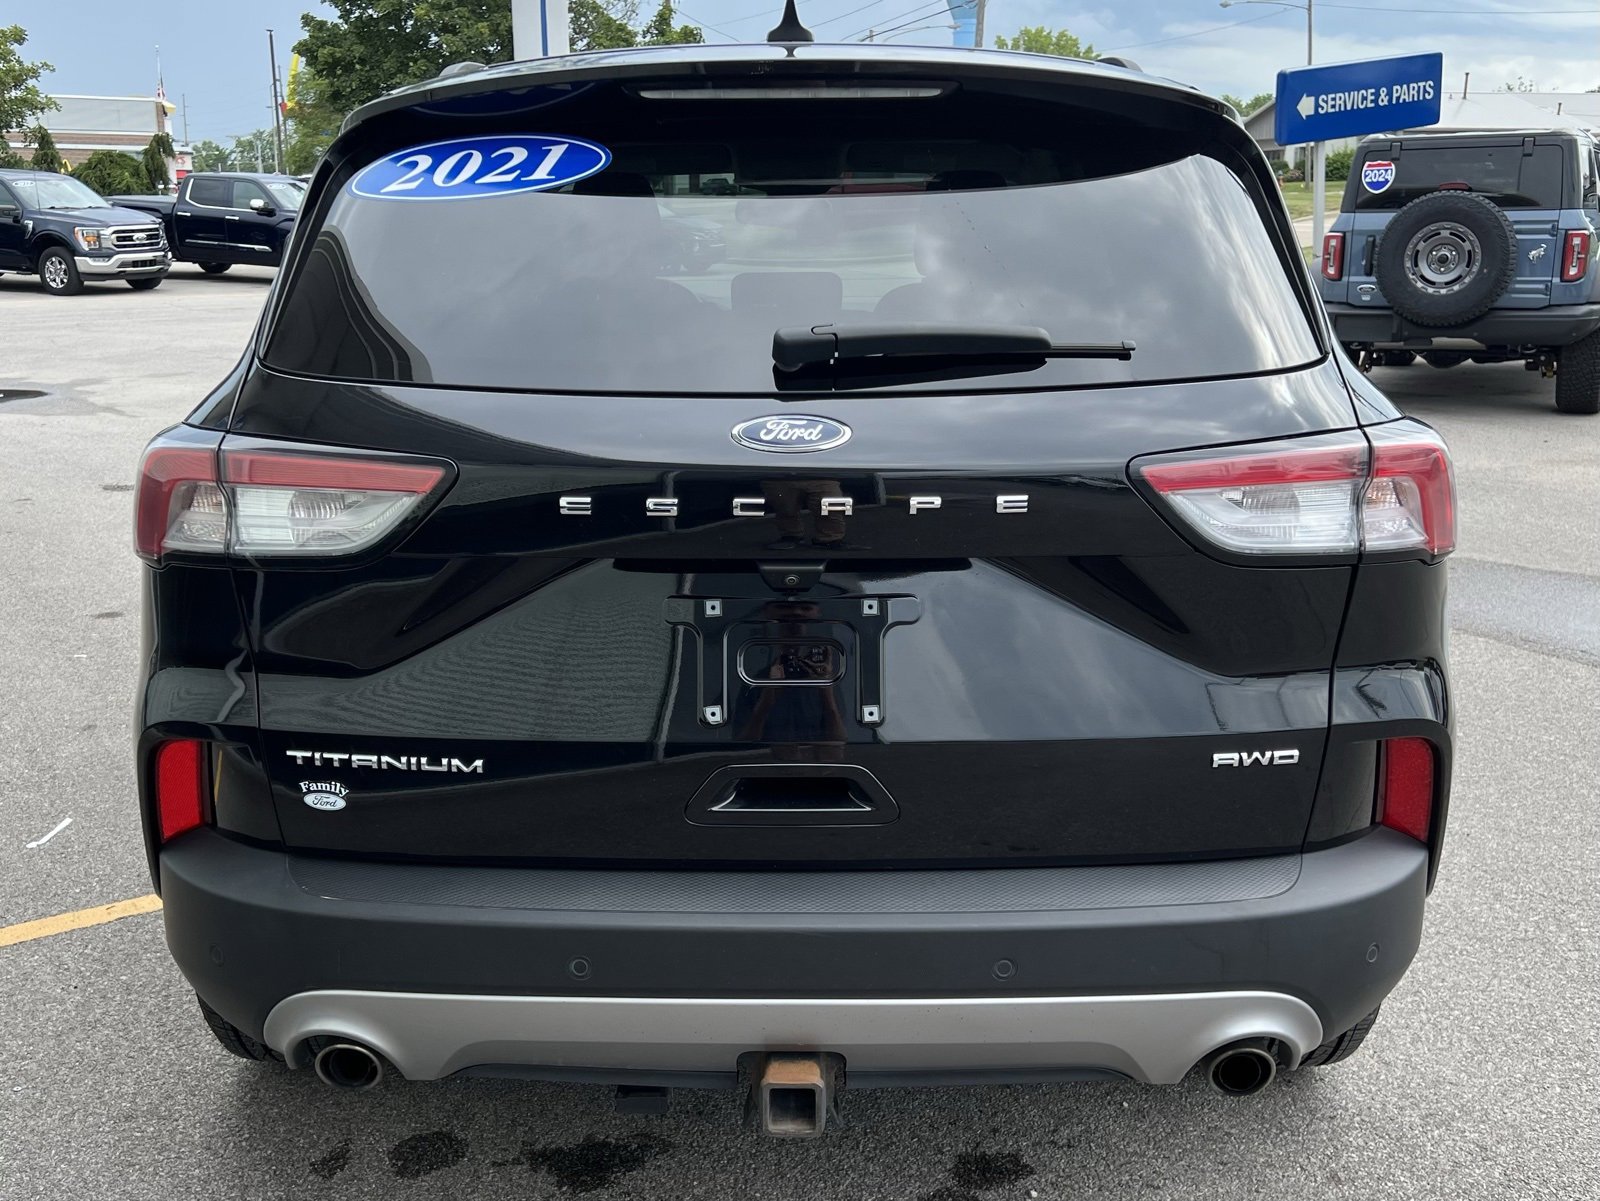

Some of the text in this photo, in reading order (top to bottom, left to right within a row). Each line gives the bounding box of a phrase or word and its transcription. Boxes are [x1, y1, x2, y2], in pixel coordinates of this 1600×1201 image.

[1318, 80, 1434, 114] SERVICE & PARTS
[380, 143, 569, 193] 2021
[1365, 170, 1391, 182] 2024
[760, 420, 823, 440] Ford
[559, 494, 1028, 516] ESCAPE
[286, 750, 484, 773] TITANIUM
[1212, 749, 1300, 768] AWD
[300, 781, 349, 797] Family
[312, 796, 337, 808] Ford
